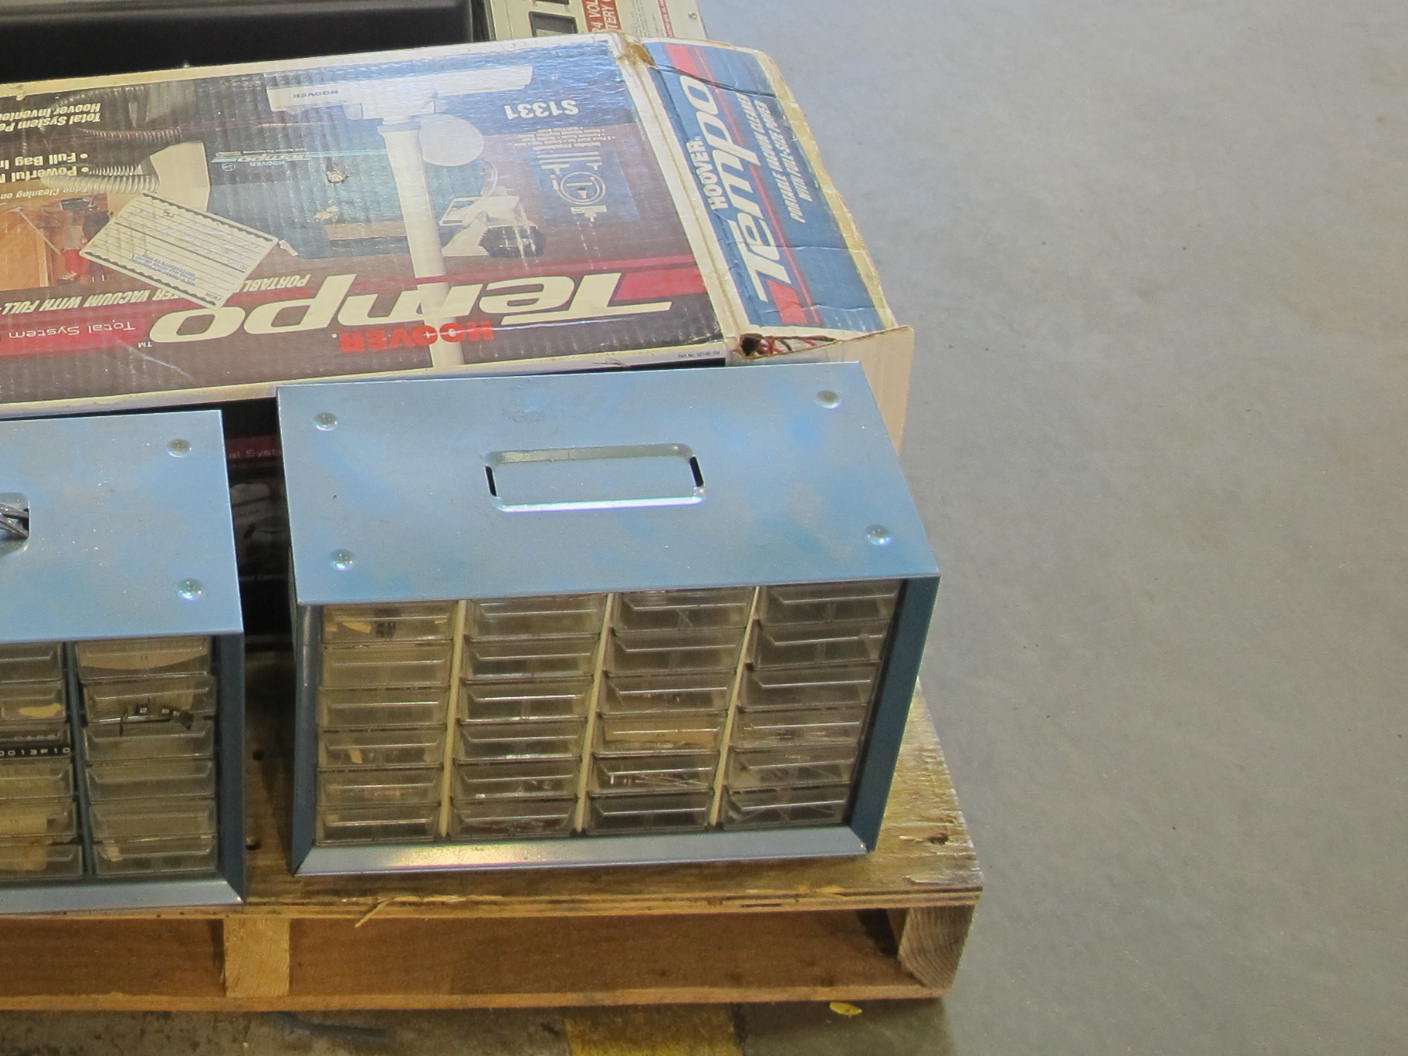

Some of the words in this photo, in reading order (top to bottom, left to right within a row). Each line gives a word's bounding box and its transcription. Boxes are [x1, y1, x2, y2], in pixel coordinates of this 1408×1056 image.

[602, 4, 618, 31] TERY
[53, 102, 101, 117] Hoover
[69, 112, 101, 125] Total
[503, 98, 580, 121] S1331
[17, 115, 67, 131] System
[14, 155, 44, 169] Bag
[49, 152, 77, 164] Full
[10, 166, 77, 184] Powerful
[686, 139, 730, 211] HOOVER
[680, 75, 791, 302] Tempo
[241, 273, 312, 294] PORTABL
[39, 294, 82, 313] WITH
[84, 288, 151, 308] VACUUM
[149, 272, 672, 344] Tempo
[8, 323, 80, 343] System
[88, 318, 136, 335] Total
[339, 321, 495, 354] HOOVER
